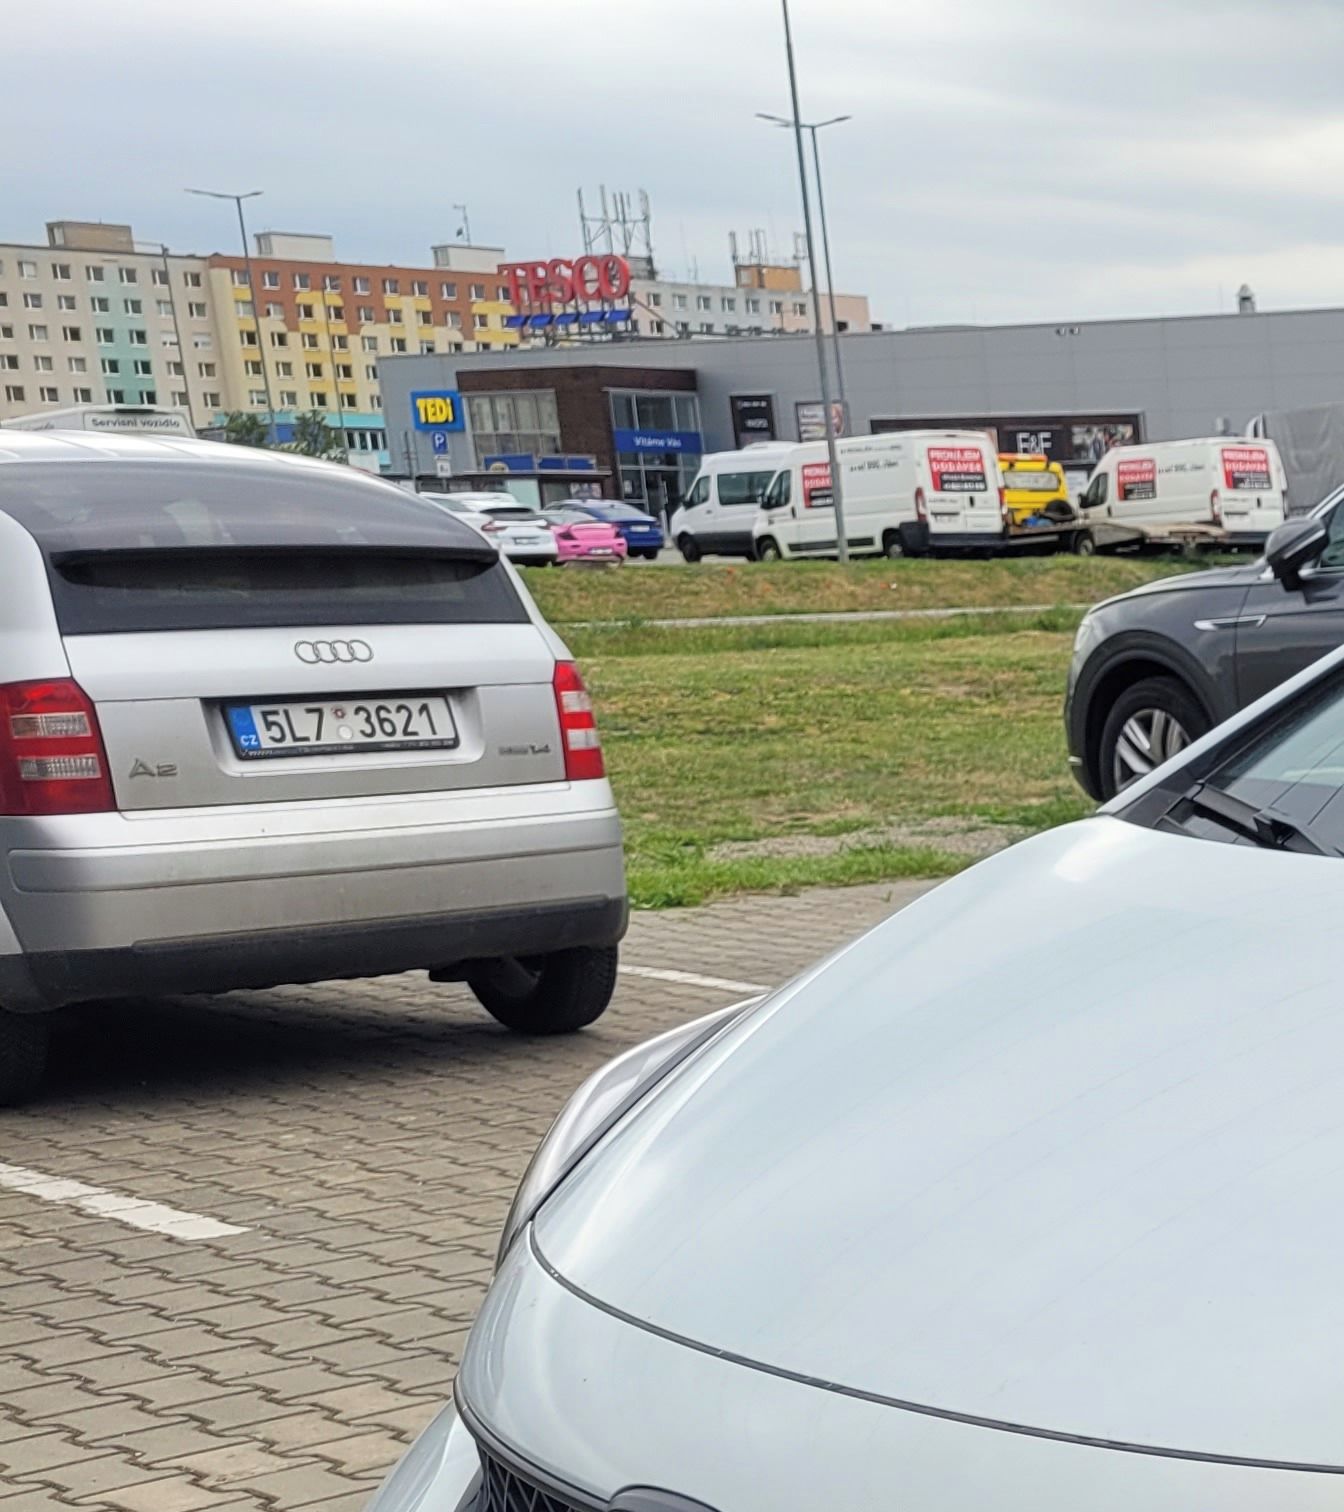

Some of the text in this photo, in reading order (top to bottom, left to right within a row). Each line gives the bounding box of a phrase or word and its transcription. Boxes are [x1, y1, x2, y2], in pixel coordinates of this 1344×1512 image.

[497, 254, 630, 305] TESCO
[434, 432, 445, 449] P
[1016, 432, 1052, 455] F&F
[260, 703, 437, 743] 5L7 3621
[240, 735, 258, 746] CZ
[129, 758, 178, 778] A2
